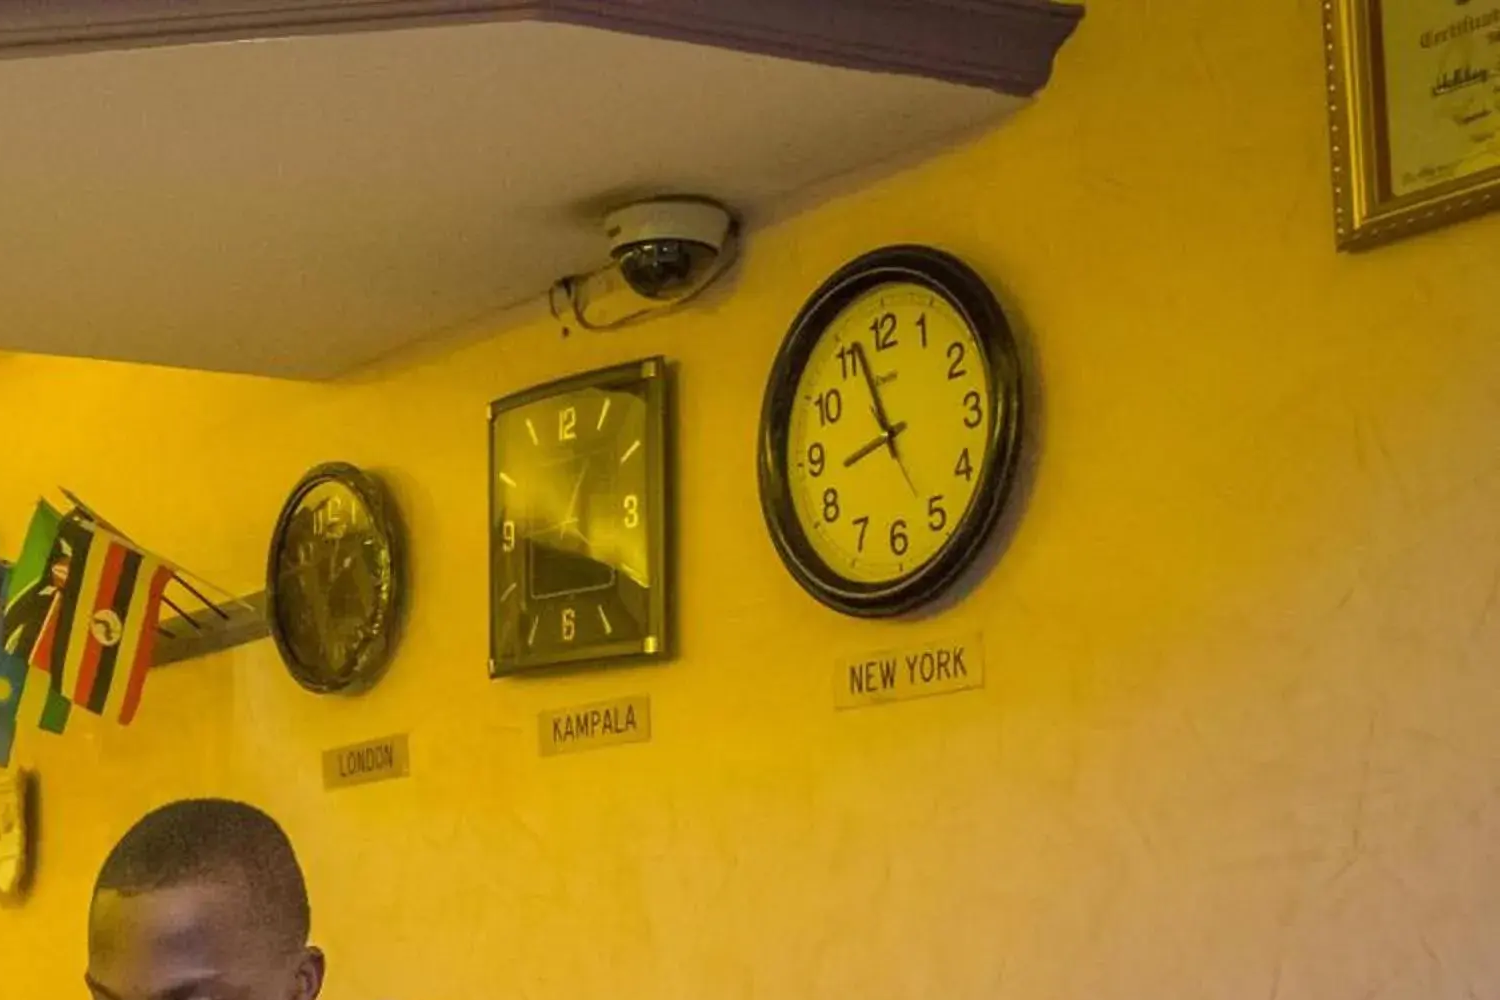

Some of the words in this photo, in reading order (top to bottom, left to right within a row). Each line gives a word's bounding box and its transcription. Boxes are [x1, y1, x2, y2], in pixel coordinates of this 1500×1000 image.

[869, 313, 898, 352] 12
[916, 313, 927, 349] 1
[836, 345, 857, 381] 11
[947, 342, 965, 380] 2
[558, 407, 576, 441] 12
[815, 388, 841, 426] 10
[963, 391, 982, 429] 3
[807, 442, 825, 476] 9
[954, 448, 973, 482] 4
[623, 495, 638, 528] 3
[823, 489, 840, 522] 8
[928, 495, 946, 531] 5
[502, 521, 515, 552] 9
[853, 517, 870, 552] 7
[890, 520, 908, 556] 6
[562, 609, 575, 641] 6
[849, 660, 896, 694] NEW
[906, 647, 968, 684] YORK
[552, 704, 637, 745] KAMPALA
[338, 745, 394, 778] LONDON
